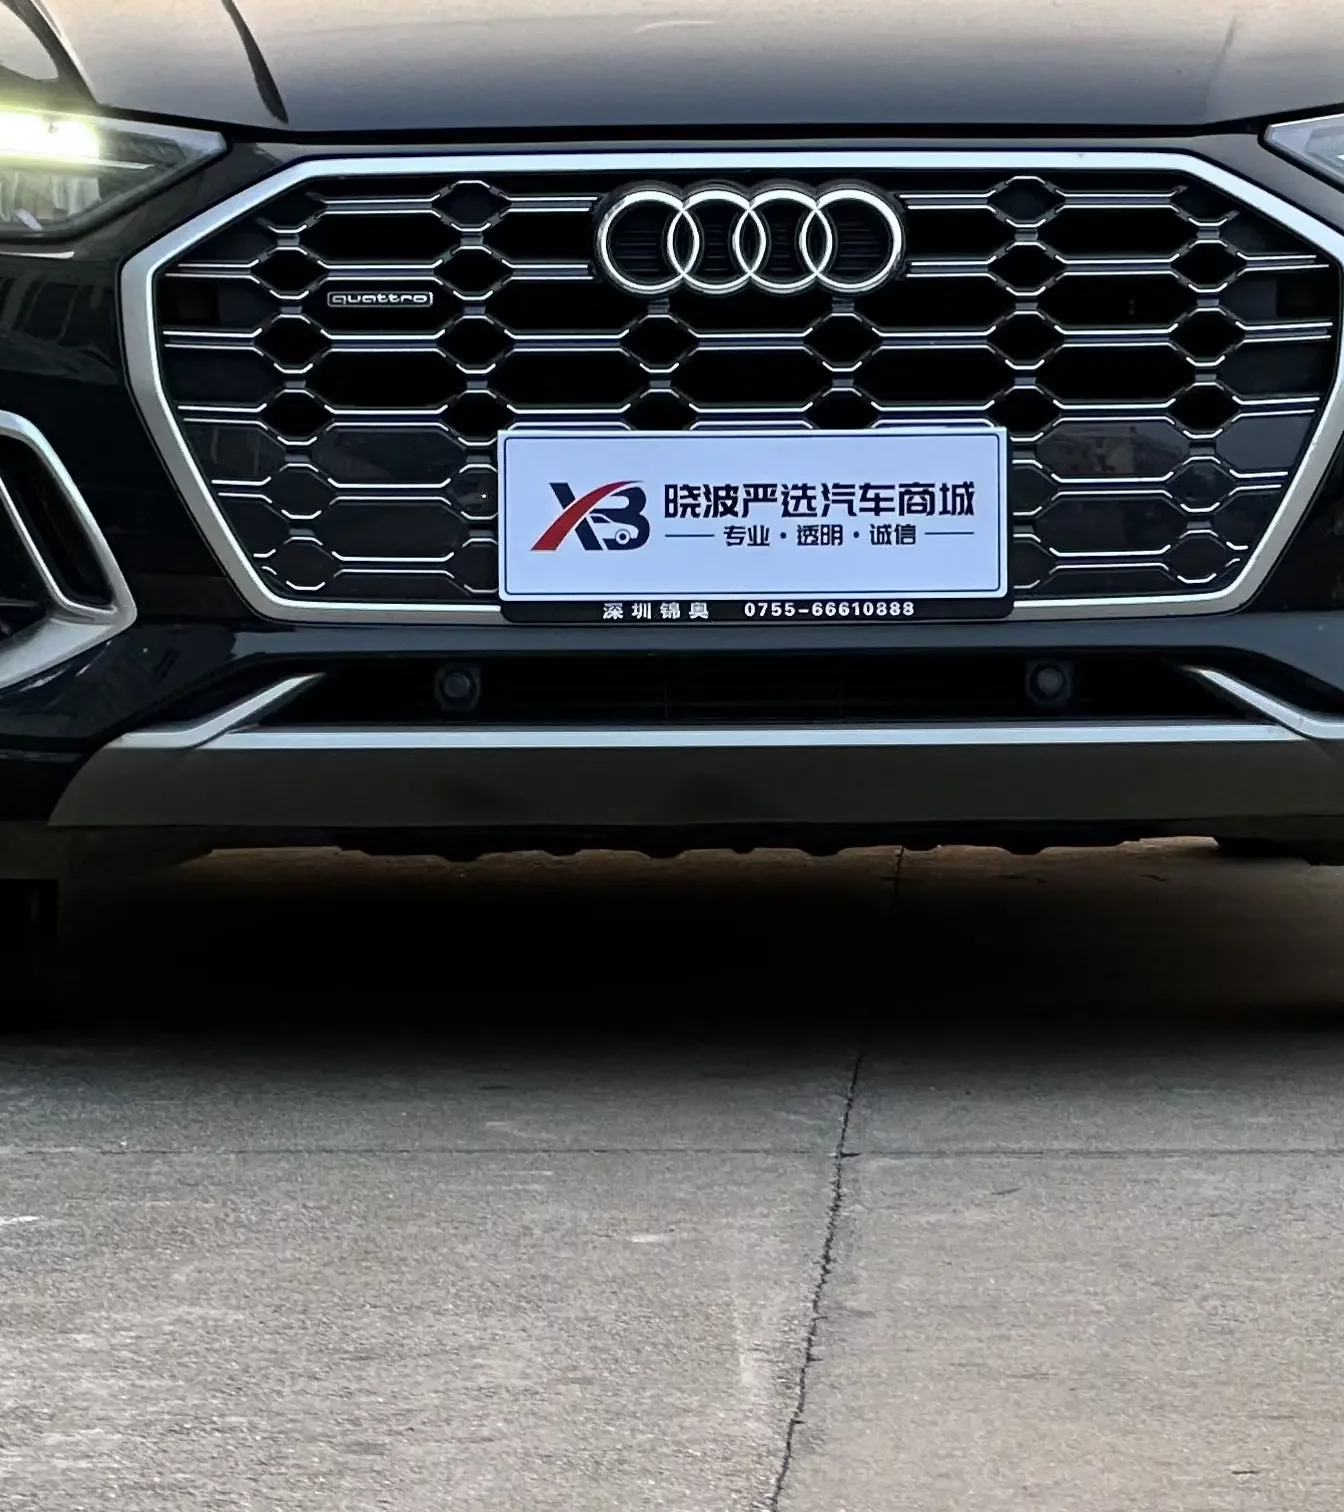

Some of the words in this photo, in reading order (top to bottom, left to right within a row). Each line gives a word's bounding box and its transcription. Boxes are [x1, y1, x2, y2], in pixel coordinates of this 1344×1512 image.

[331, 293, 428, 305] quattro
[664, 481, 975, 519] 晓波严选汽车商城
[602, 602, 710, 620] 深圳锦奥
[744, 601, 915, 617] 0755-66610888
